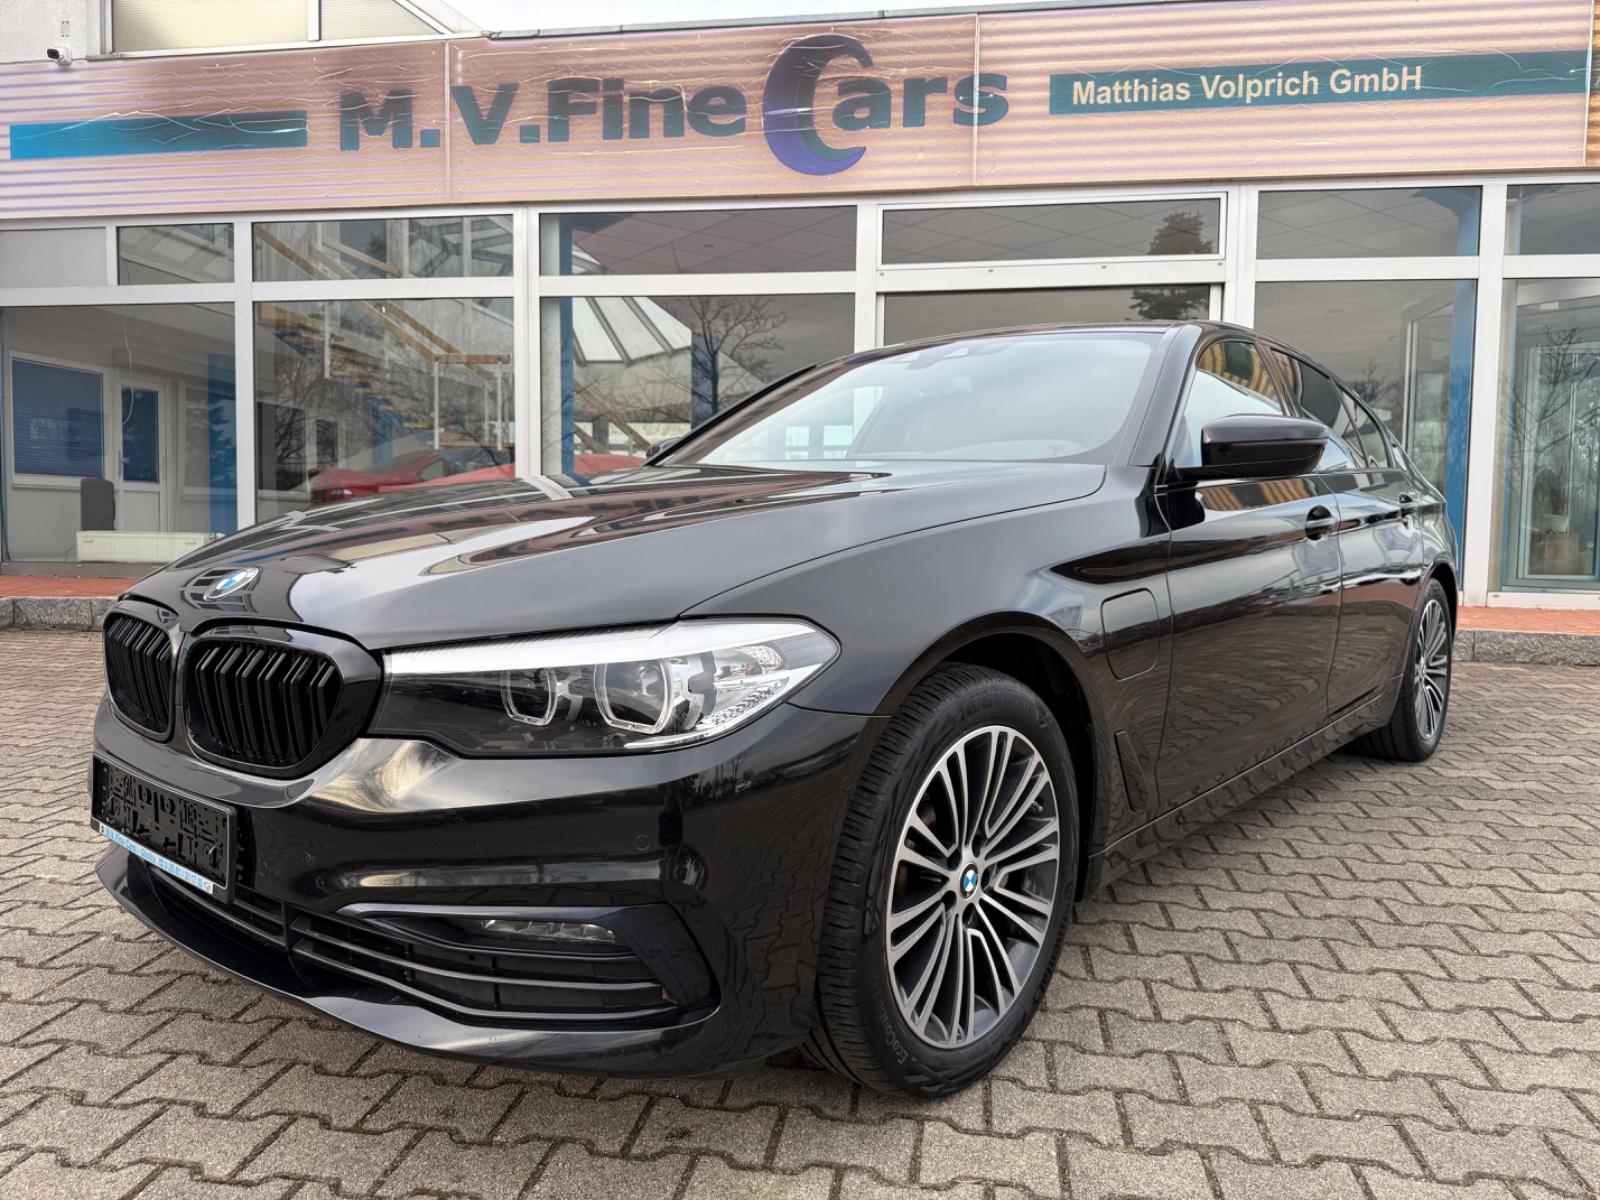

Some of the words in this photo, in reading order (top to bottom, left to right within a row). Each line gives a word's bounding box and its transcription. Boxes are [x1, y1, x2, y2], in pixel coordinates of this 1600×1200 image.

[763, 34, 1009, 175] Cars
[1072, 77, 1191, 106] Matthias
[1199, 71, 1319, 104] Volprich
[1329, 65, 1422, 94] GmbH
